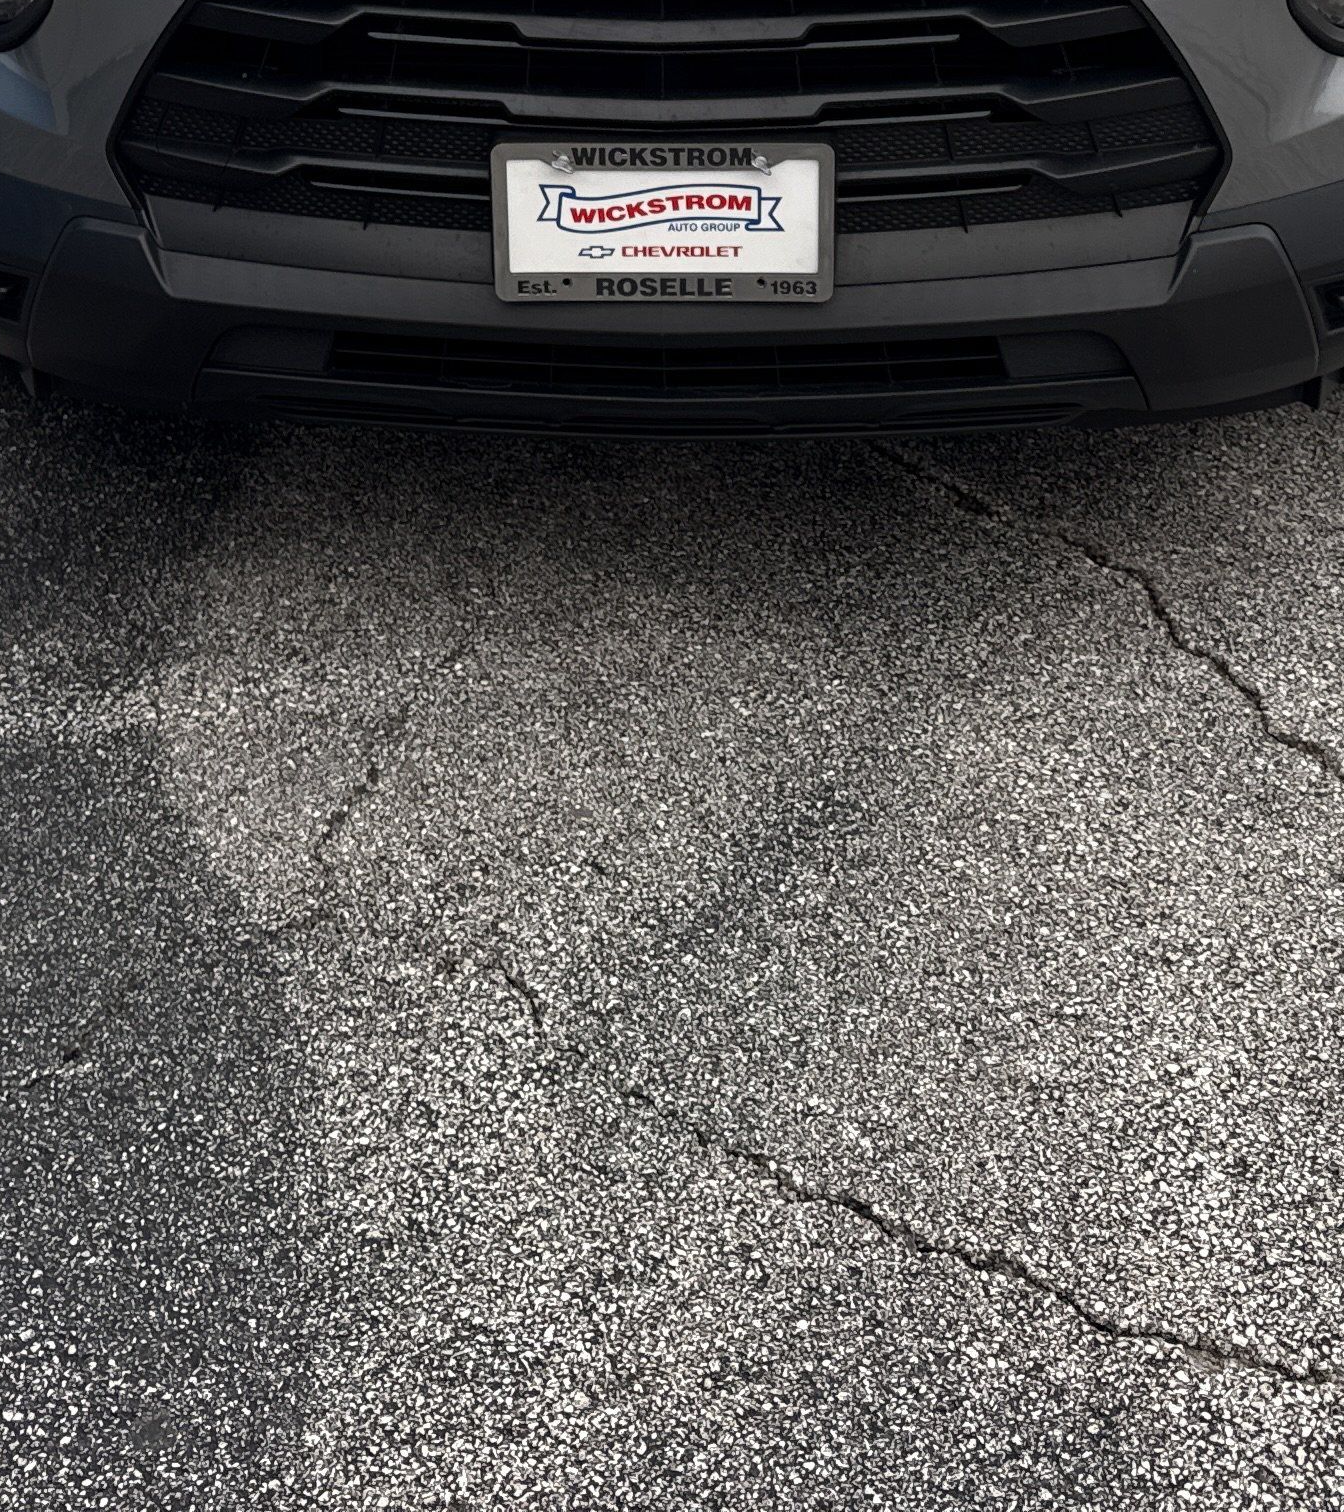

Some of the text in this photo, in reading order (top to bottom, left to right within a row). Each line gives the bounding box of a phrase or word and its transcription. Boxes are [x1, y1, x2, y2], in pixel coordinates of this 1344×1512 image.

[571, 147, 754, 167] WICKSTROM
[570, 194, 752, 224] WICKSTROM
[668, 223, 740, 232] AUTO GROUP
[621, 245, 743, 258] CHEVROLET
[517, 277, 818, 298] Est. ROSELLE 1963
